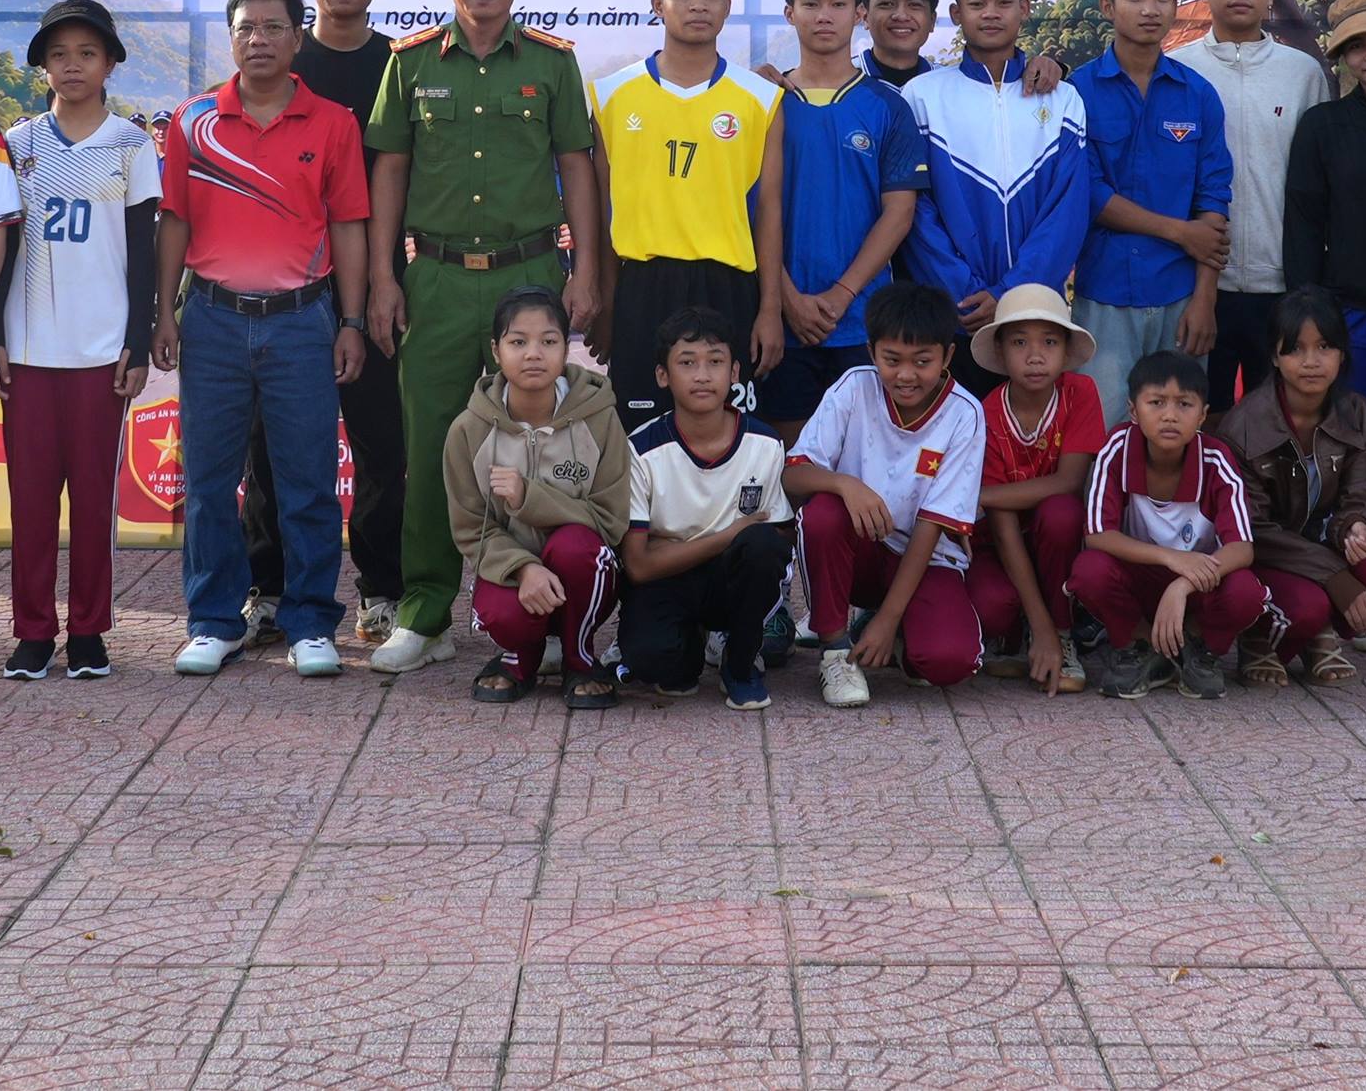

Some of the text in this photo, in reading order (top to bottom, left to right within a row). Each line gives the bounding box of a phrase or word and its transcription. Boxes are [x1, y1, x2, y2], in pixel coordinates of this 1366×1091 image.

[385, 7, 448, 29] ngày
[511, 5, 559, 31] áng
[565, 6, 580, 26] 6
[586, 6, 640, 26] năm
[665, 139, 698, 178] 17
[43, 196, 92, 243] 20
[730, 380, 757, 413] 28
